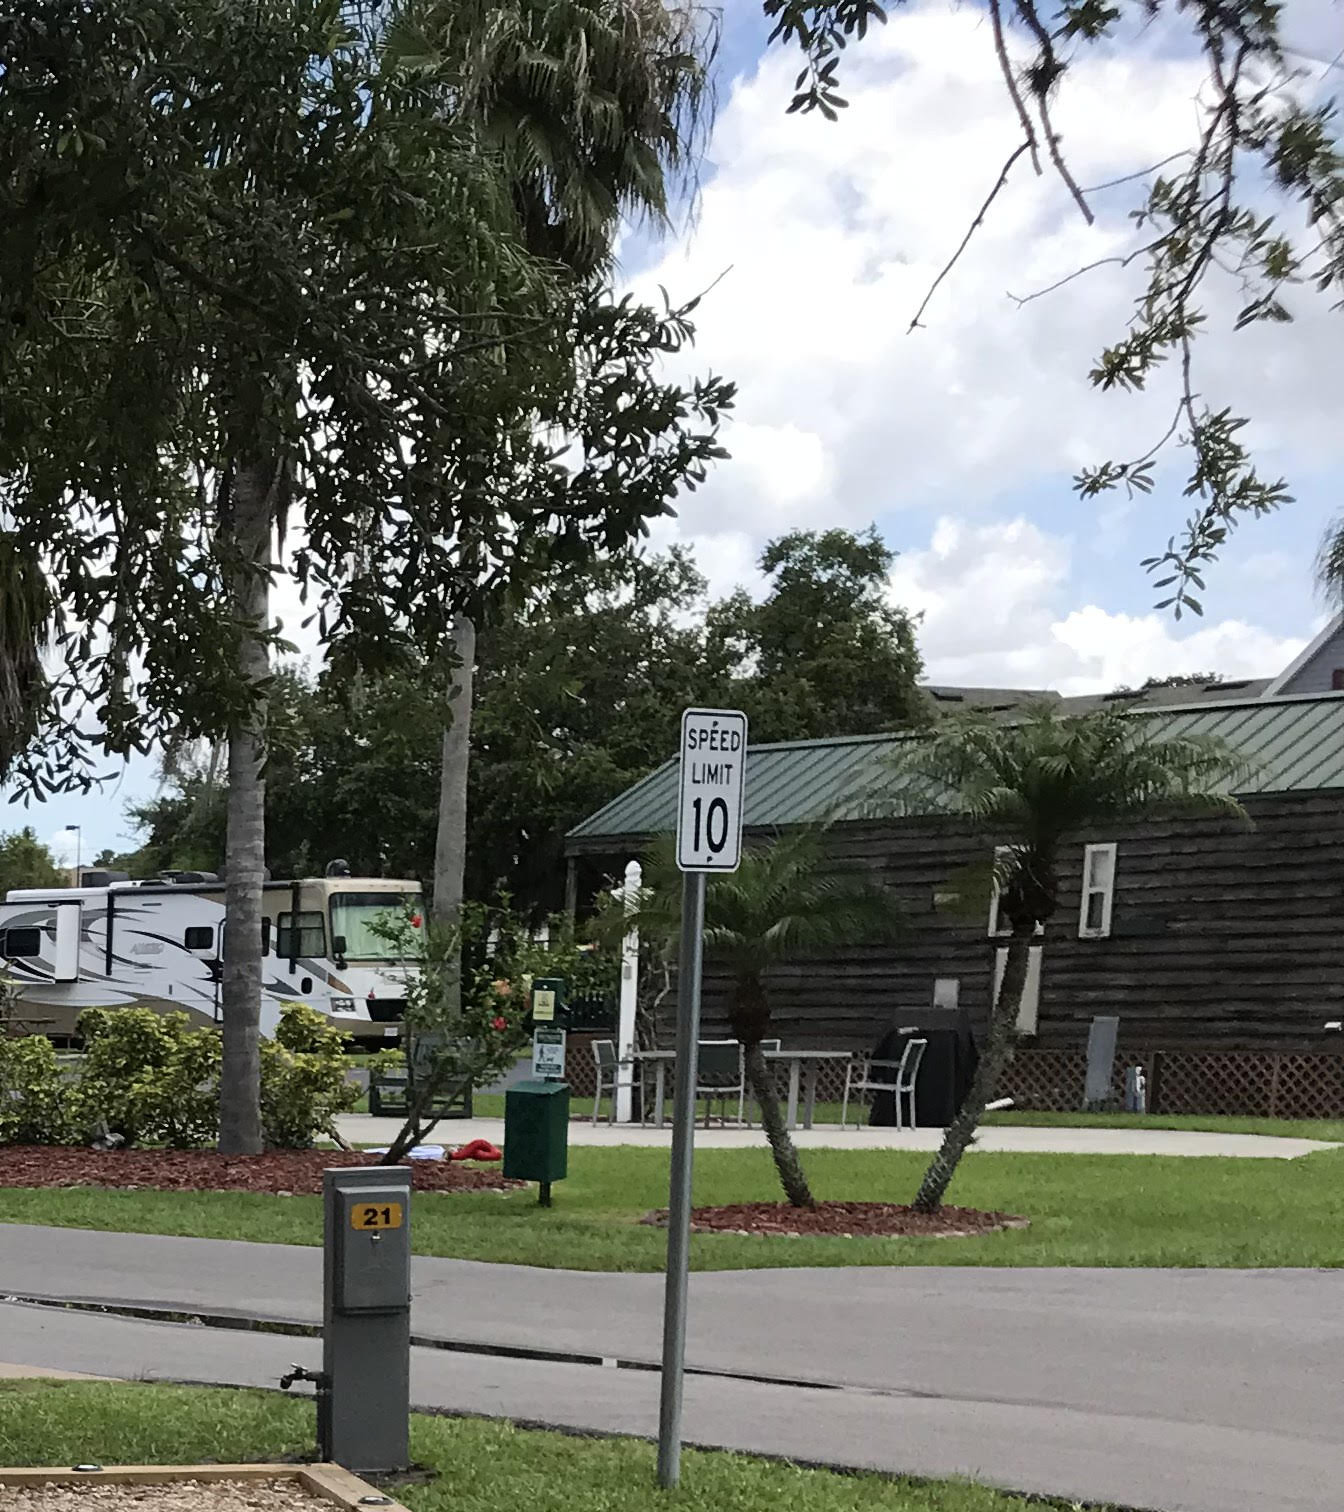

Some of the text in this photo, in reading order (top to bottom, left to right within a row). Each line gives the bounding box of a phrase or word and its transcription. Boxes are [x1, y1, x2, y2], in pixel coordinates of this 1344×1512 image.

[687, 728, 741, 752] SPEED
[692, 762, 733, 785] LIMIT
[693, 797, 729, 853] 10
[363, 1207, 391, 1226] 21
